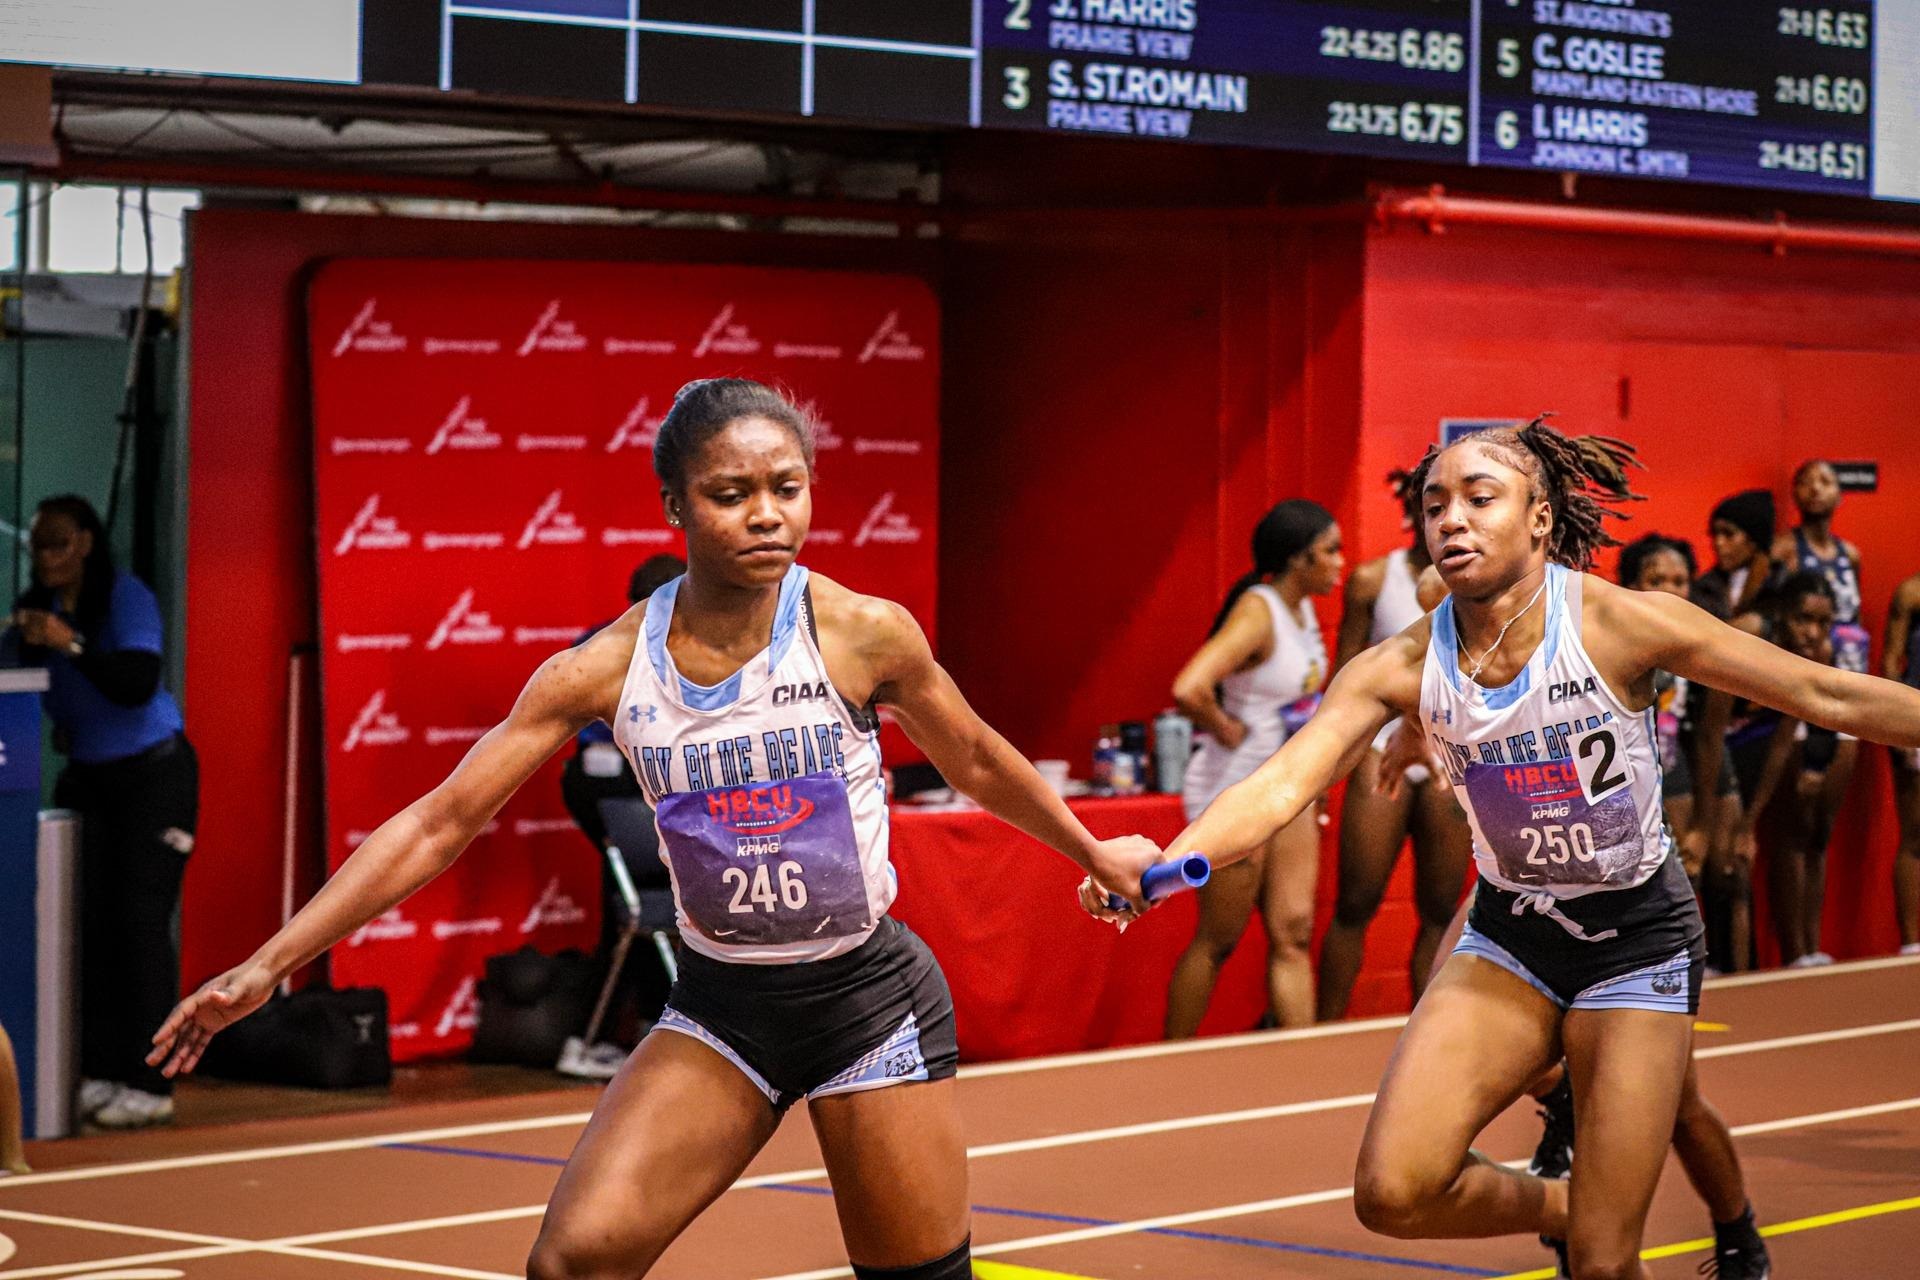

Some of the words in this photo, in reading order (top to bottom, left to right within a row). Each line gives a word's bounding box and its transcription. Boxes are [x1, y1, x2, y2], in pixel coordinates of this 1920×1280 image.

[1003, 0, 1031, 30] 2
[1082, 0, 1197, 31] HARRIS
[1815, 9, 1868, 48] 6.63
[1048, 20, 1134, 55] PRAIRIE
[1135, 31, 1194, 61] VIEW
[1400, 28, 1464, 73] 6.86
[1497, 39, 1520, 78] 5
[1563, 36, 1665, 79] GOSLEE
[1003, 65, 1031, 110] 3
[1048, 59, 1080, 98] S.
[1813, 74, 1867, 114] 6.60
[1047, 99, 1134, 134] PRAIRIE
[1134, 106, 1193, 138] VIEW
[1400, 102, 1464, 145] 6.75
[1495, 110, 1519, 149] 6
[1552, 105, 1649, 147] HARRIS
[1820, 141, 1866, 180] 6.51
[773, 682, 829, 707] CIAA
[1549, 677, 1597, 704] CIAA
[1504, 762, 1578, 788] HBCU
[1579, 730, 1627, 798] 2
[707, 785, 793, 816] HBCU
[1531, 806, 1570, 820] KPMG
[736, 842, 780, 857] KPMG
[1520, 823, 1596, 866] 250
[722, 860, 808, 914] 246
